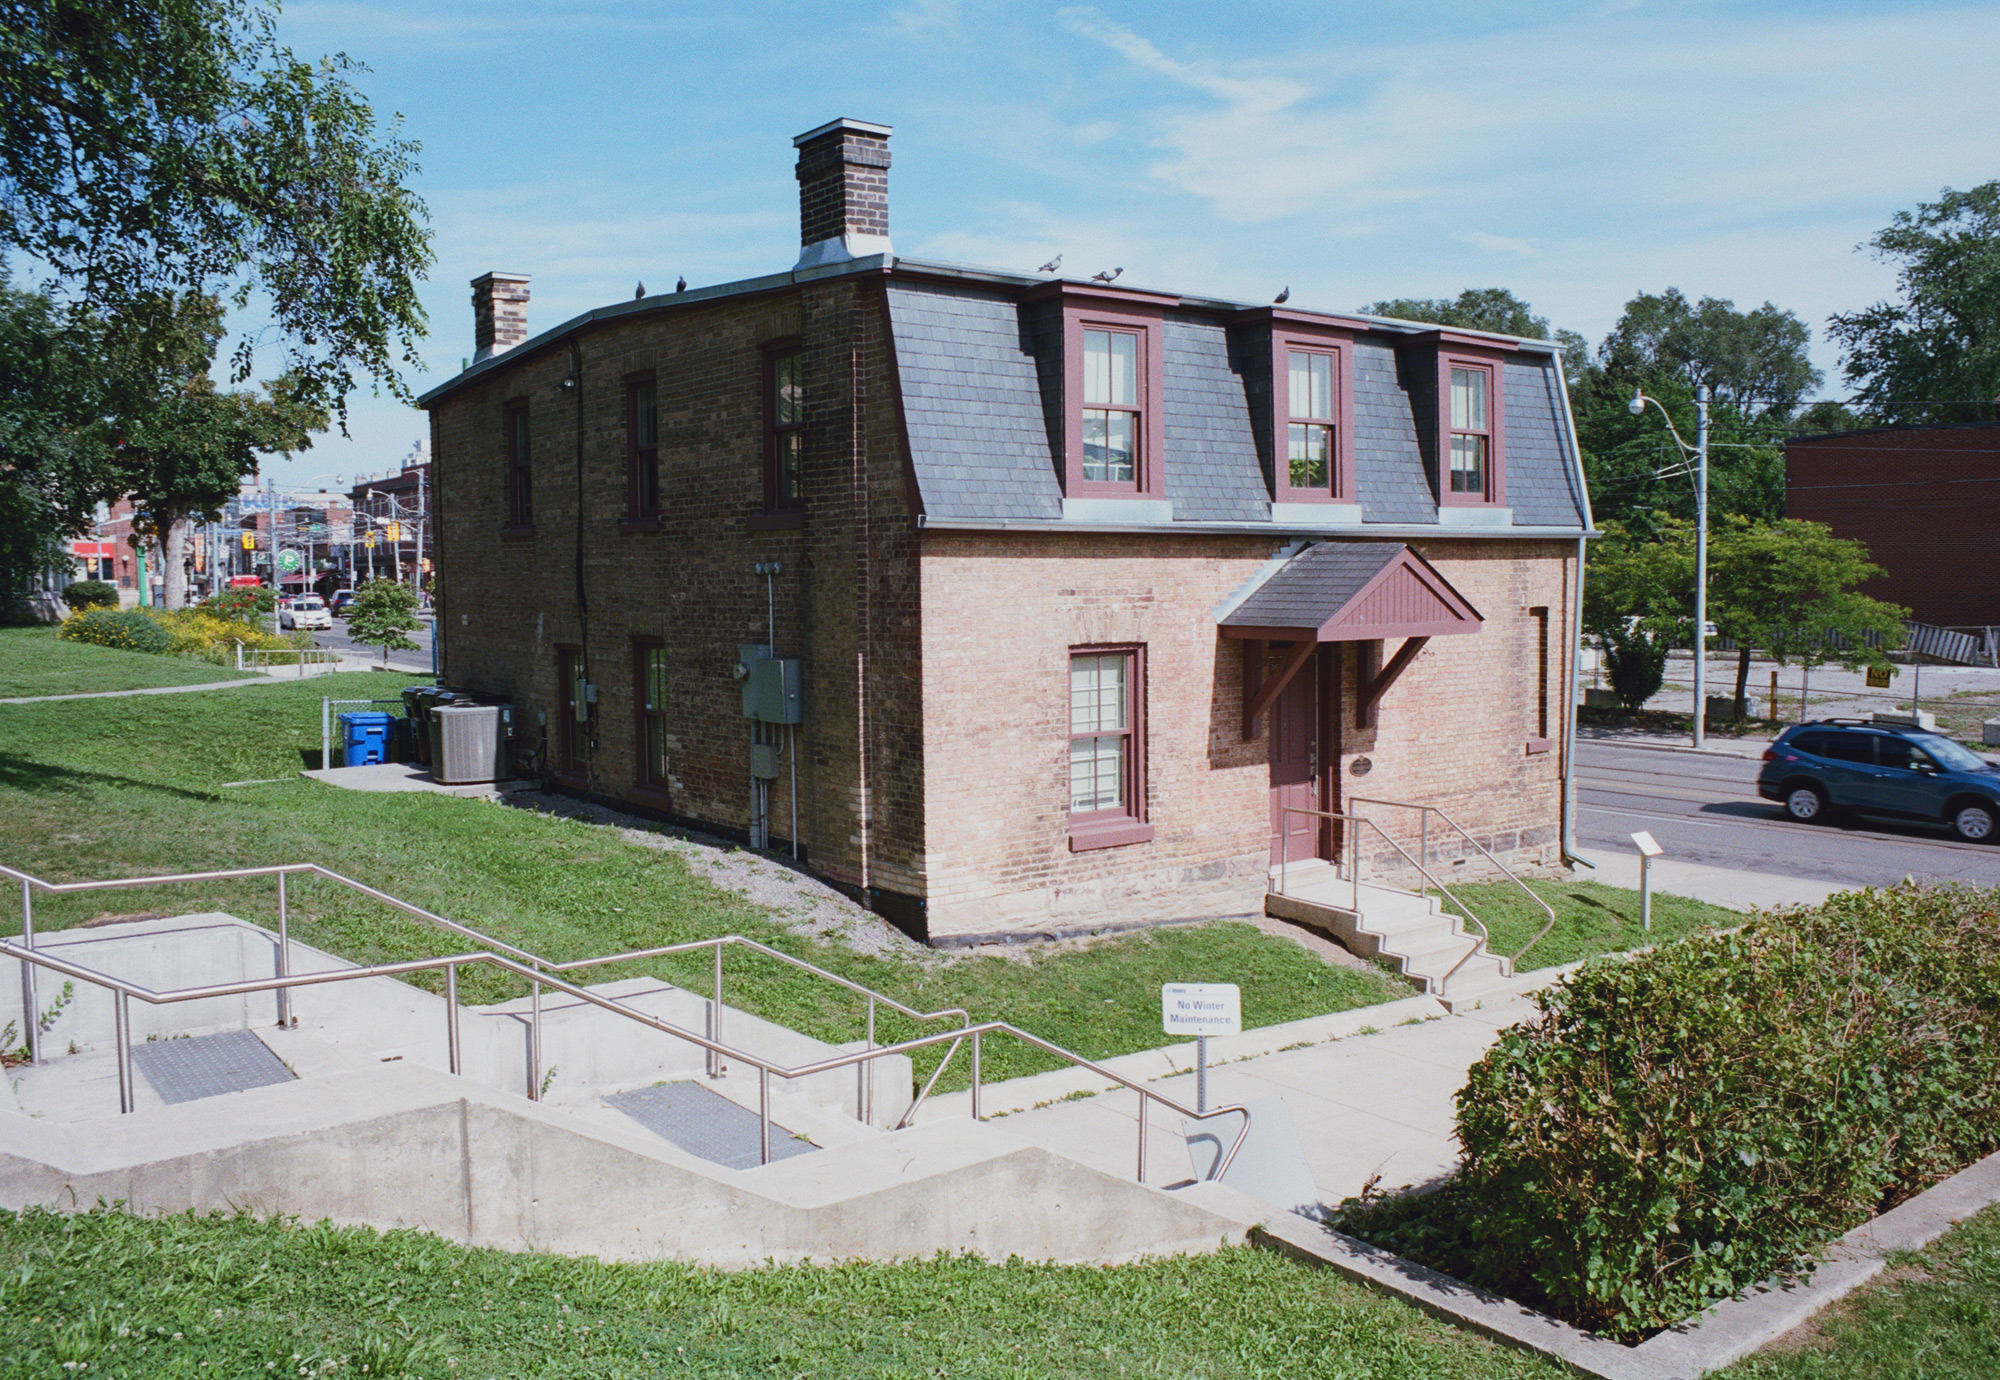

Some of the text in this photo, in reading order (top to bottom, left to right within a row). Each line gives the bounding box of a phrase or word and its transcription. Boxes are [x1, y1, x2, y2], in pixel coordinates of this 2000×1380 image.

[1871, 669, 1888, 679] NO
[1177, 1000, 1225, 1010] No Winter
[1170, 1013, 1233, 1024] Maintenance.
